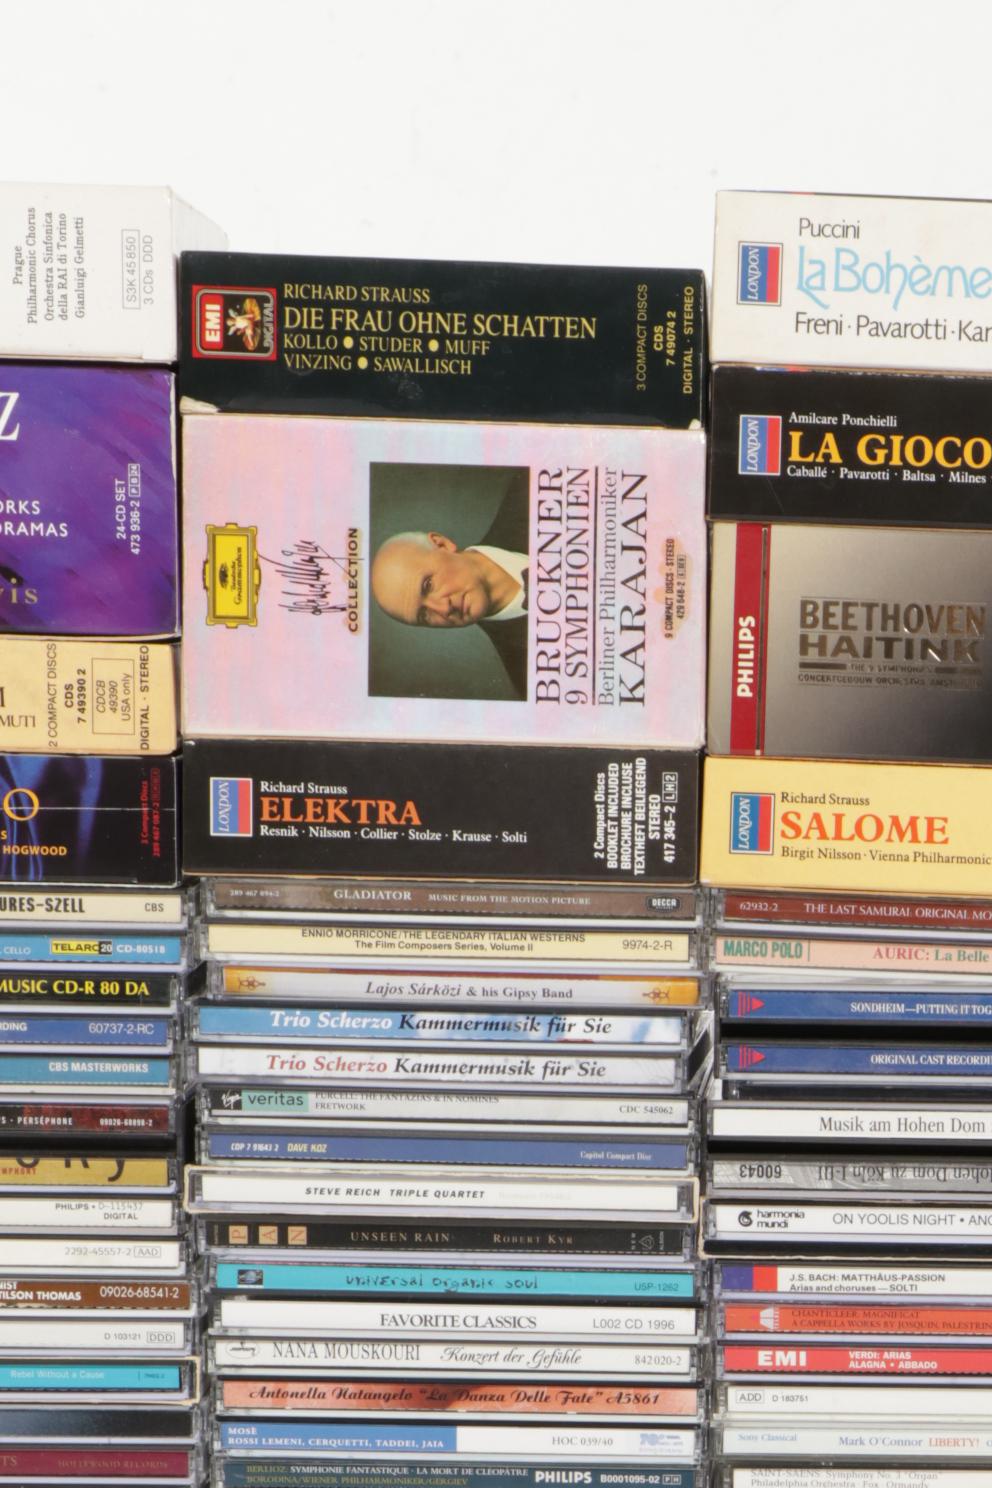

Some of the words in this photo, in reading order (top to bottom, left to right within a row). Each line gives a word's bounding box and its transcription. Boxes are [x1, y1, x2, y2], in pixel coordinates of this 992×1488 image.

[799, 218, 859, 239] Puccini
[744, 247, 759, 299] LONDON
[284, 284, 357, 300] RICHARD
[361, 287, 430, 303] STRAUSS
[204, 296, 221, 343] EMI
[285, 307, 324, 329] DIE
[331, 308, 392, 332] FRAU
[399, 311, 467, 335] OHNE
[473, 314, 596, 338] SCHATTEN
[796, 312, 842, 335] Freni
[857, 315, 946, 340] Pavarotti
[284, 333, 337, 349] KOLLO
[360, 336, 422, 353] STUDER
[446, 339, 490, 355] MUFF
[284, 353, 351, 370] VINZING
[374, 357, 471, 374] SAWALLISCH
[789, 412, 838, 424] Amilcare
[842, 414, 897, 427] Ponchielli
[788, 431, 842, 463] LA
[787, 465, 827, 478] Caballé
[840, 467, 889, 480] Pavarotti
[903, 470, 935, 481] Baltsa
[949, 471, 986, 483] Milnes
[599, 468, 616, 620] Philharmoniker
[348, 528, 358, 632] COLLECTION
[565, 467, 589, 678] SYMPHONIEN
[536, 469, 562, 704] BRUCKNER
[619, 471, 647, 706] KARAJAN
[799, 601, 985, 634] BEETHOVEN
[737, 616, 755, 697] PHILIPS
[799, 636, 979, 662] HAITINK
[598, 637, 614, 705] Berliner
[568, 690, 587, 704] 9
[261, 781, 304, 793] Richard
[308, 783, 347, 794] Strauss
[781, 792, 825, 804] Richard
[829, 793, 870, 806] Strauss
[261, 797, 421, 825] ELEKTRA
[260, 825, 298, 836] Resnik
[309, 826, 350, 838] Nilsson
[361, 828, 398, 839] Collier
[408, 830, 442, 842] Stolze
[453, 830, 491, 842] Krause
[502, 831, 527, 842] Solti
[739, 797, 752, 849] LONDON
[781, 811, 949, 844] SALOME
[15, 845, 67, 855] HOGWOOD
[781, 847, 811, 861] Birgit
[818, 848, 861, 860] Nilsson
[869, 850, 909, 862] Vienna
[913, 851, 991, 864] Philharmonic
[334, 889, 411, 900] GLADIATOR
[724, 940, 768, 958] MARCO
[772, 941, 803, 959] POLO
[267, 1055, 306, 1070] Trio
[314, 1056, 387, 1072] Scherzo
[394, 1057, 533, 1077] Kammermusik
[542, 1059, 575, 1079] für
[578, 1062, 605, 1076] Sie
[248, 1092, 304, 1108] veritas
[820, 1116, 864, 1131] Musik
[870, 1121, 890, 1132] am
[898, 1117, 944, 1132] Hohen
[951, 1118, 984, 1133] Dom
[305, 1187, 344, 1197] STEVE
[349, 1188, 384, 1198] REICH
[390, 1189, 428, 1197] TRIPLE
[435, 1189, 485, 1200] QUARTET
[381, 1314, 458, 1327] FAVORITE
[463, 1316, 536, 1328] CLASSICS
[273, 1341, 319, 1360] NANA
[324, 1342, 420, 1361] MOUSKOURI
[758, 1351, 806, 1366] EMI
[535, 1471, 592, 1483] PHILIPS
